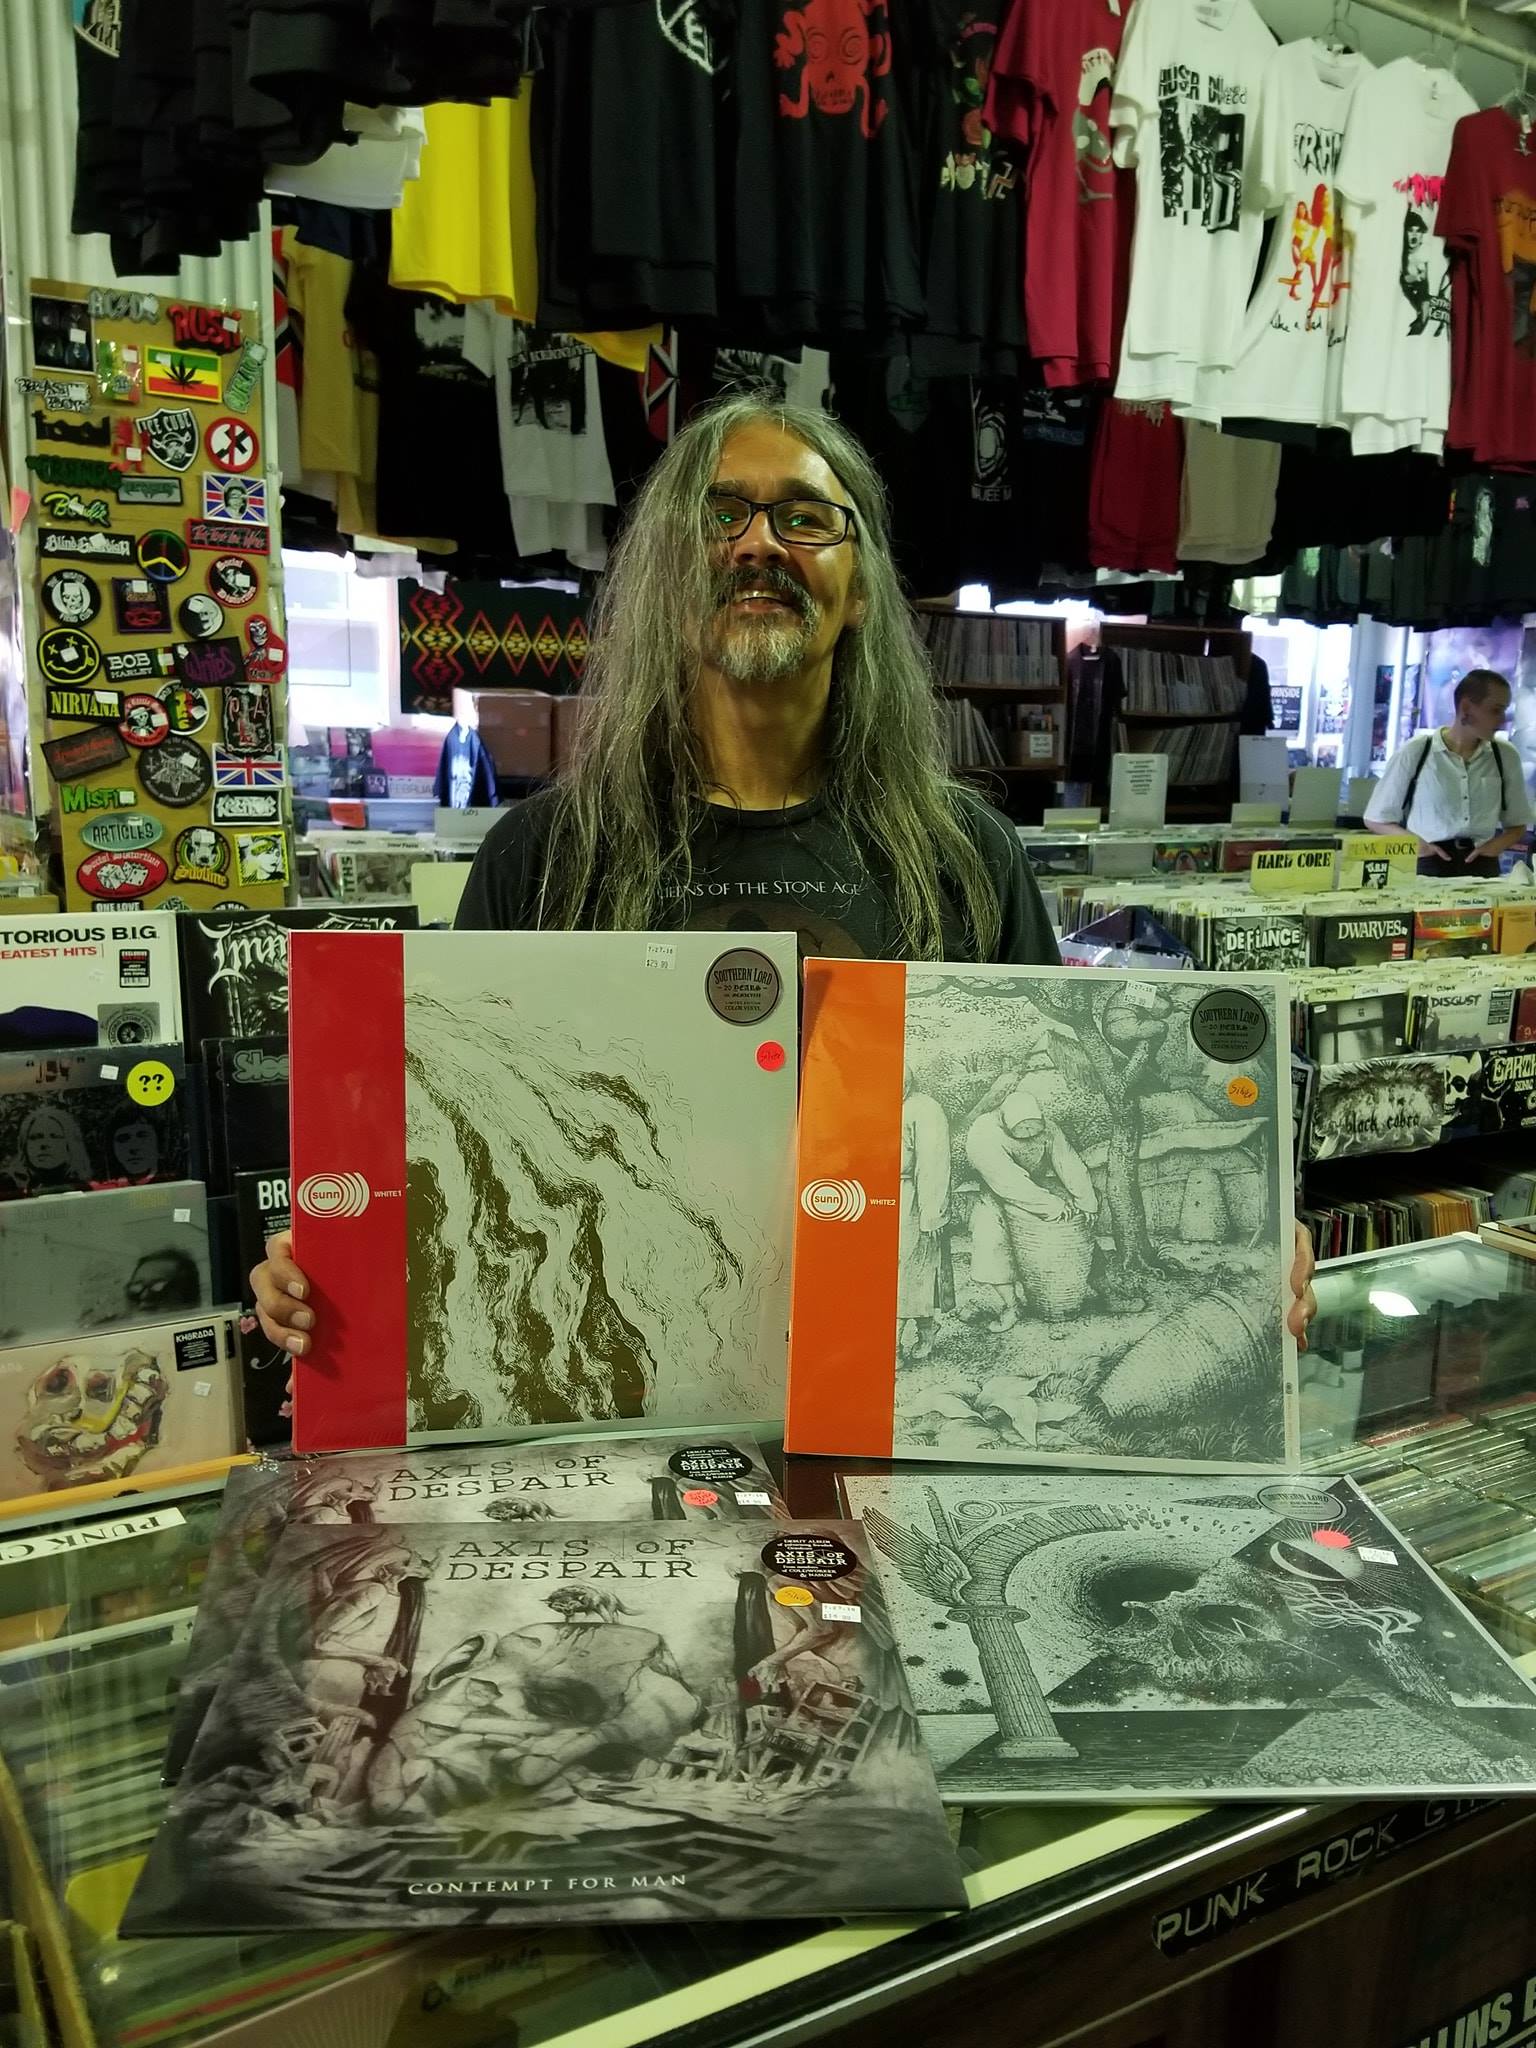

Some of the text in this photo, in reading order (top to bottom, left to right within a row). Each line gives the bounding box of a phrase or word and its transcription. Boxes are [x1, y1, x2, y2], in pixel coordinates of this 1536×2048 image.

[107, 652, 151, 671] BOB
[1384, 842, 1418, 856] ROCK
[1296, 852, 1332, 868] CORE
[708, 882, 731, 896] OF
[735, 881, 769, 895] THE
[773, 880, 827, 896] STONE
[831, 881, 861, 896] AGE
[1337, 919, 1402, 941] DWARVES
[63, 946, 97, 957] HITS
[713, 967, 773, 986] SOUTHERN LORD
[1430, 994, 1482, 1008] DISGUST
[1198, 1007, 1238, 1024] SOUTHERN
[258, 1177, 290, 1211] BR
[312, 1189, 341, 1200] sunn
[814, 1195, 840, 1204] sunn
[387, 1455, 610, 1485] AXIS OF
[389, 1471, 616, 1502] DESPAIR
[0, 1543, 35, 1561] C
[448, 1539, 697, 1560] AXIS OF
[774, 1550, 845, 1559] AXIS OF
[446, 1559, 699, 1581] DESPAIR
[775, 1557, 848, 1566] DESPAIR
[408, 1873, 687, 1896] CONTEMPT FOR MAN
[1157, 1813, 1399, 1950] PUNK ROCK
